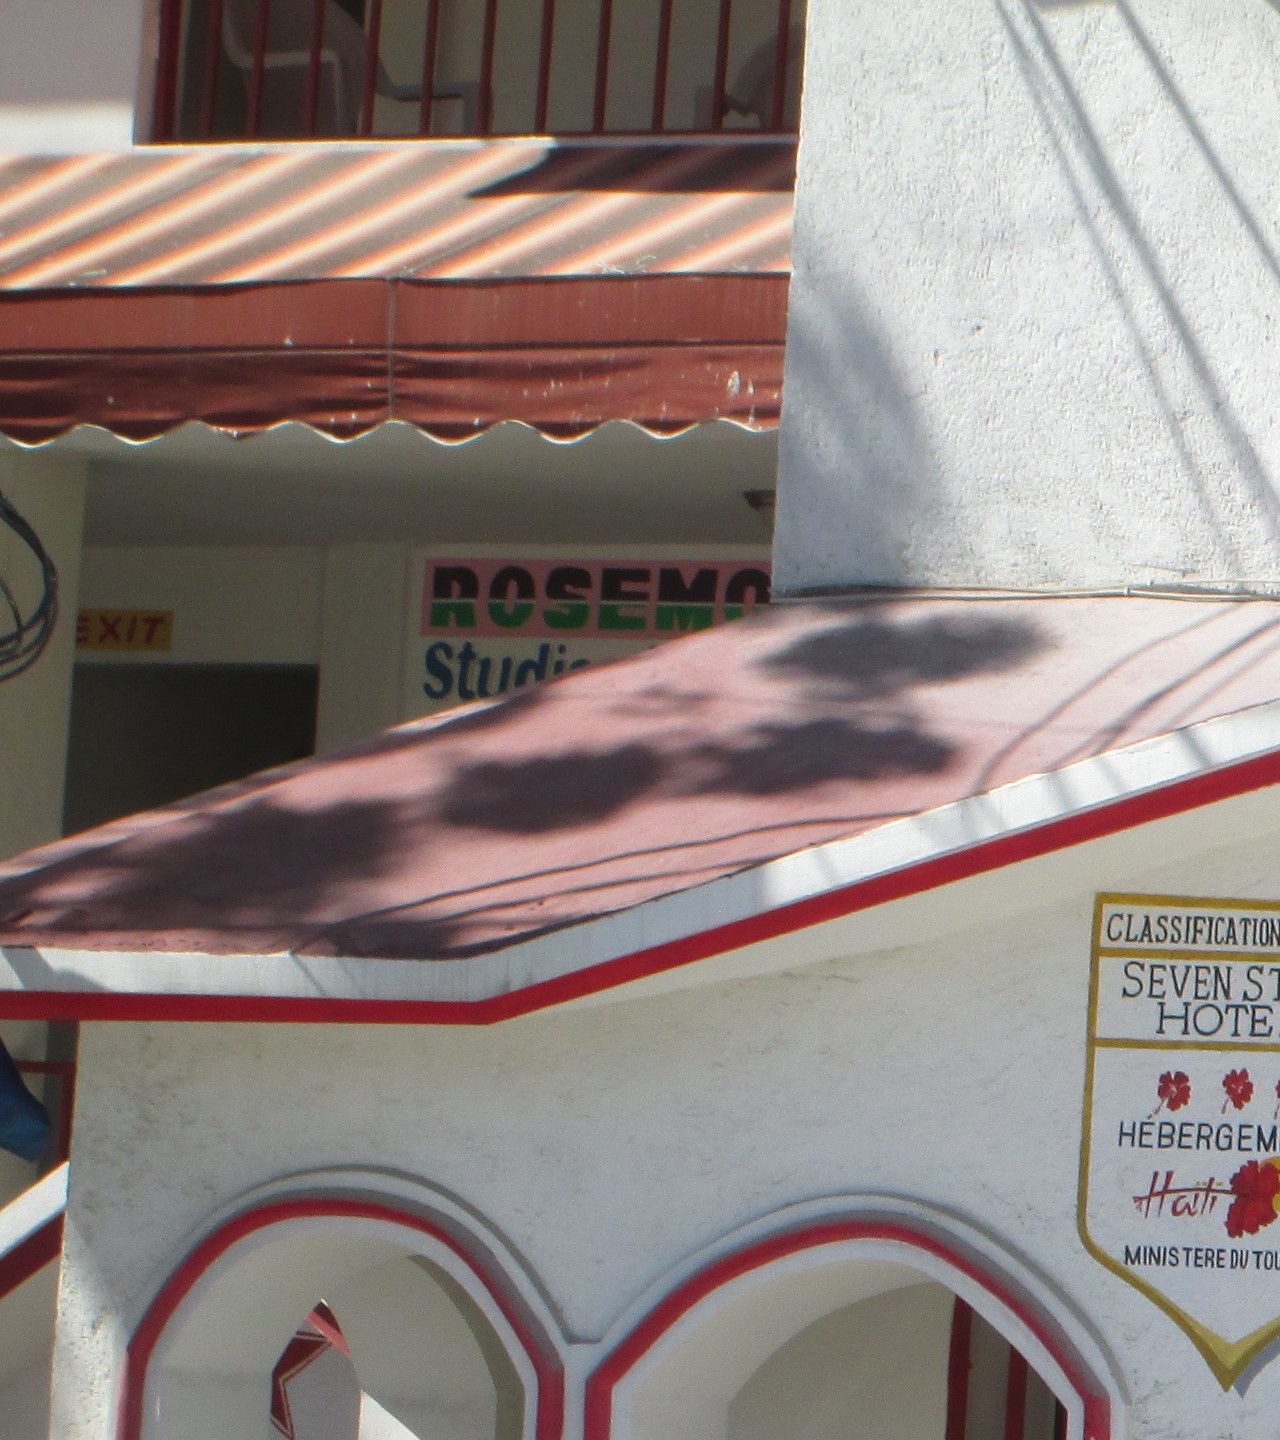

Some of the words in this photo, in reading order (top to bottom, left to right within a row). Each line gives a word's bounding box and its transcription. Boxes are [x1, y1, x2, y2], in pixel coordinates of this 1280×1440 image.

[76, 615, 164, 645] EXIT
[1121, 961, 1232, 1000] SEVEN
[1230, 1249, 1249, 1270] DU
